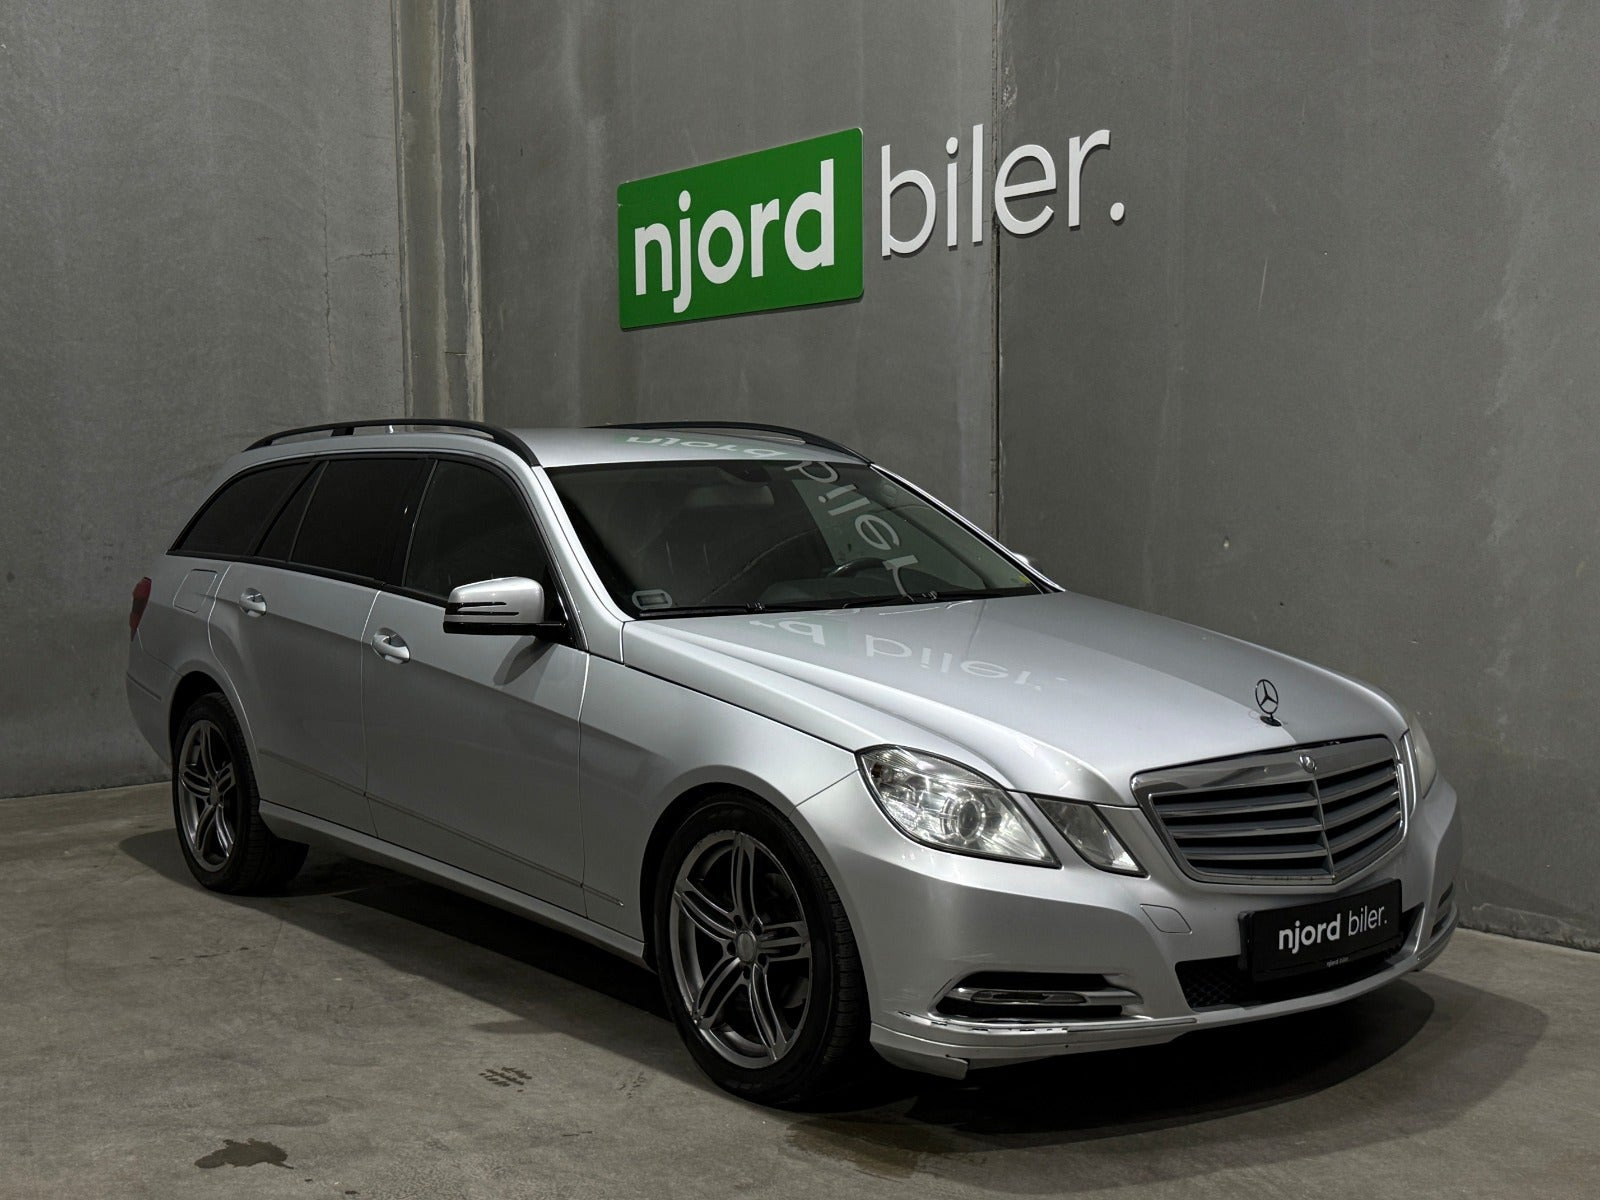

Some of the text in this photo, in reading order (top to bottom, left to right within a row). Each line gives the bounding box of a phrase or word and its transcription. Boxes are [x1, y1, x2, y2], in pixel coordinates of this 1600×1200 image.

[634, 124, 1125, 313] njord biler.
[1278, 905, 1388, 954] njord biler.
